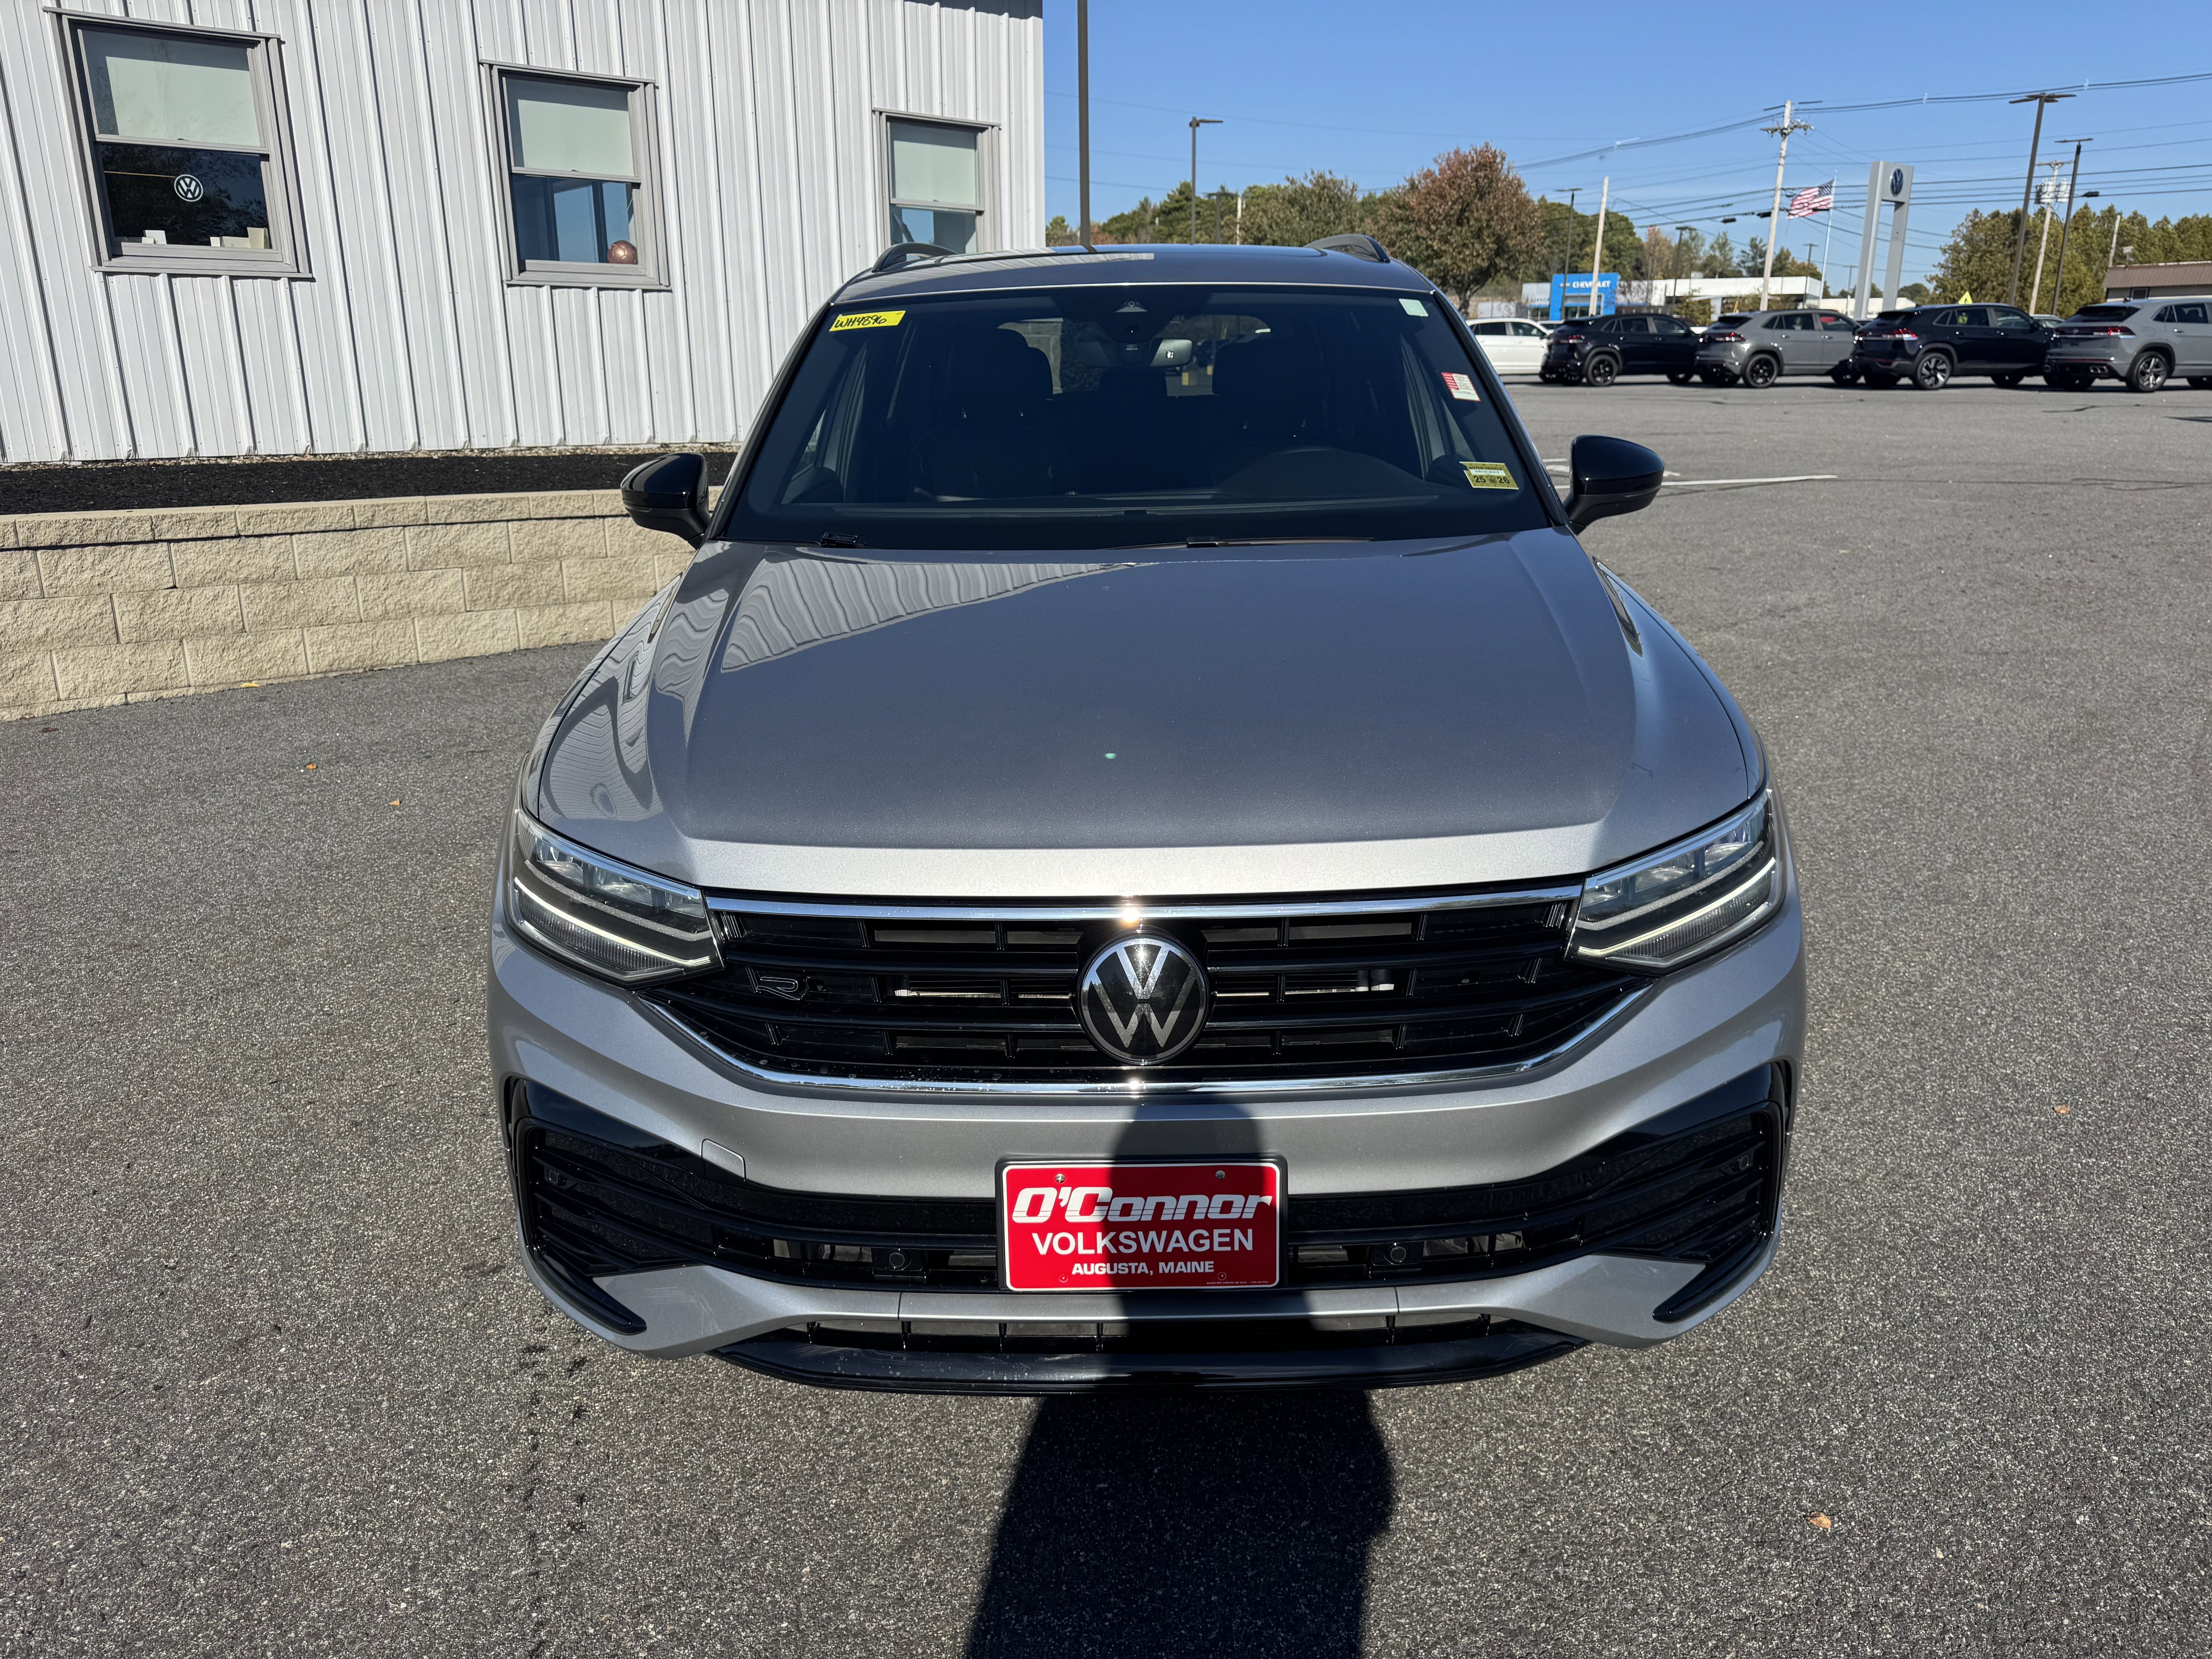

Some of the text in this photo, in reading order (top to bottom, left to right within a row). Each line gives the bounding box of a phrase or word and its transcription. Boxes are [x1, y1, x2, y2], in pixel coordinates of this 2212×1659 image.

[1572, 280, 1611, 289] CHEVLET
[834, 315, 887, 328] WH4896
[1012, 1186, 1273, 1223] O'Connor
[1032, 1228, 1254, 1255] VOLKSWAGEN
[1072, 1261, 1214, 1276] AUGUSTA, MAINE
